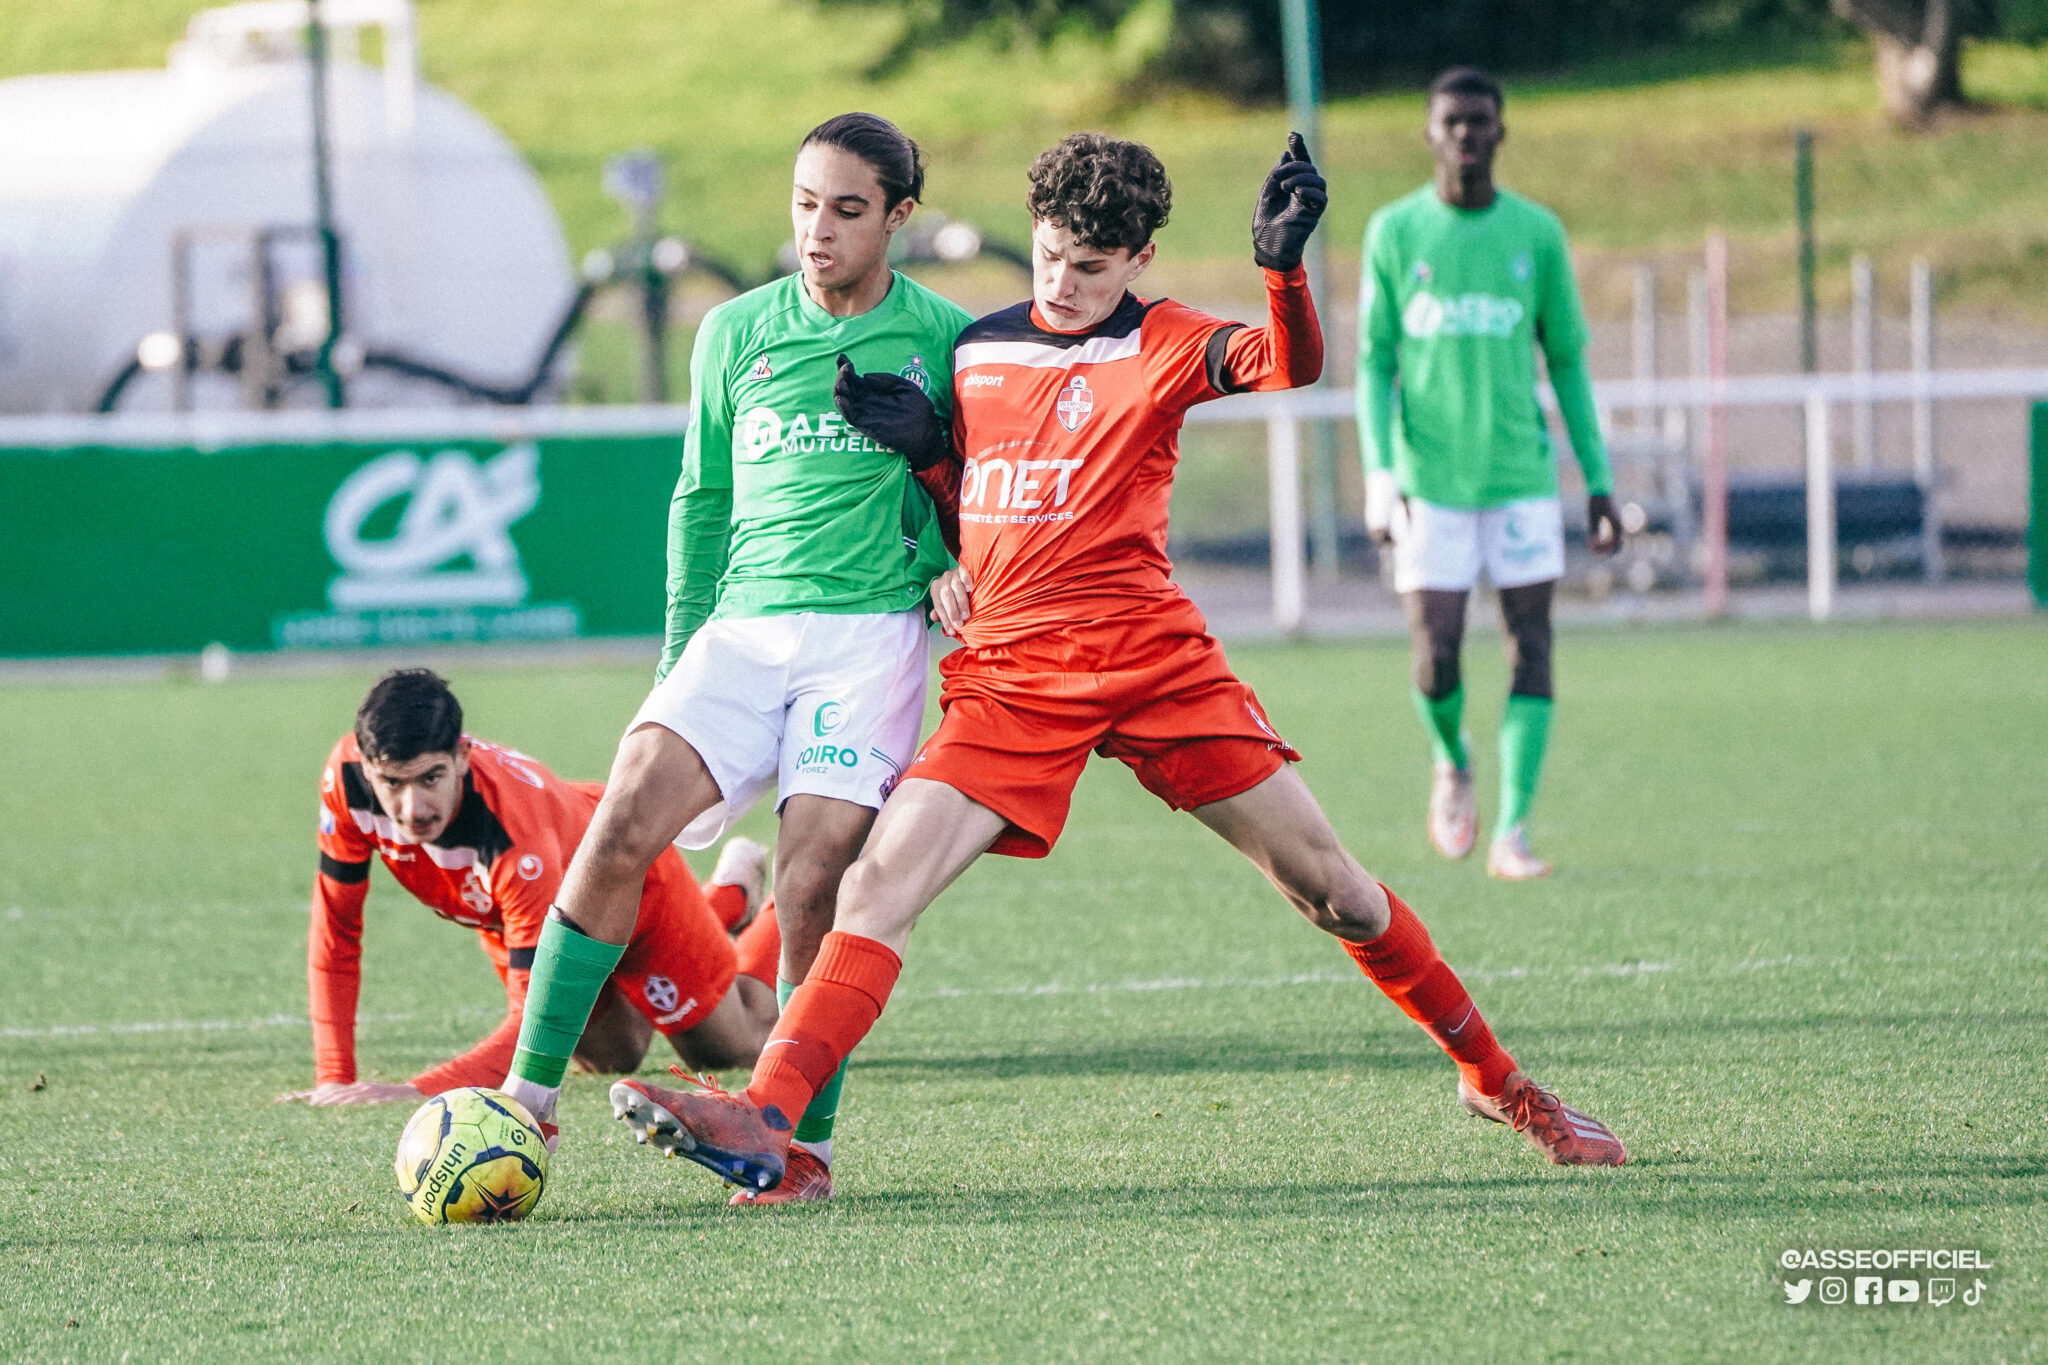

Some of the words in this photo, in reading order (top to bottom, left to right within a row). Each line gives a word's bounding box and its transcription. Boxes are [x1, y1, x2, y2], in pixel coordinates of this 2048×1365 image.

[781, 435, 896, 454] MUTUELL
[994, 514, 1009, 524] ET
[1010, 511, 1074, 524] SERVICES
[422, 1142, 467, 1217] uhlsport
